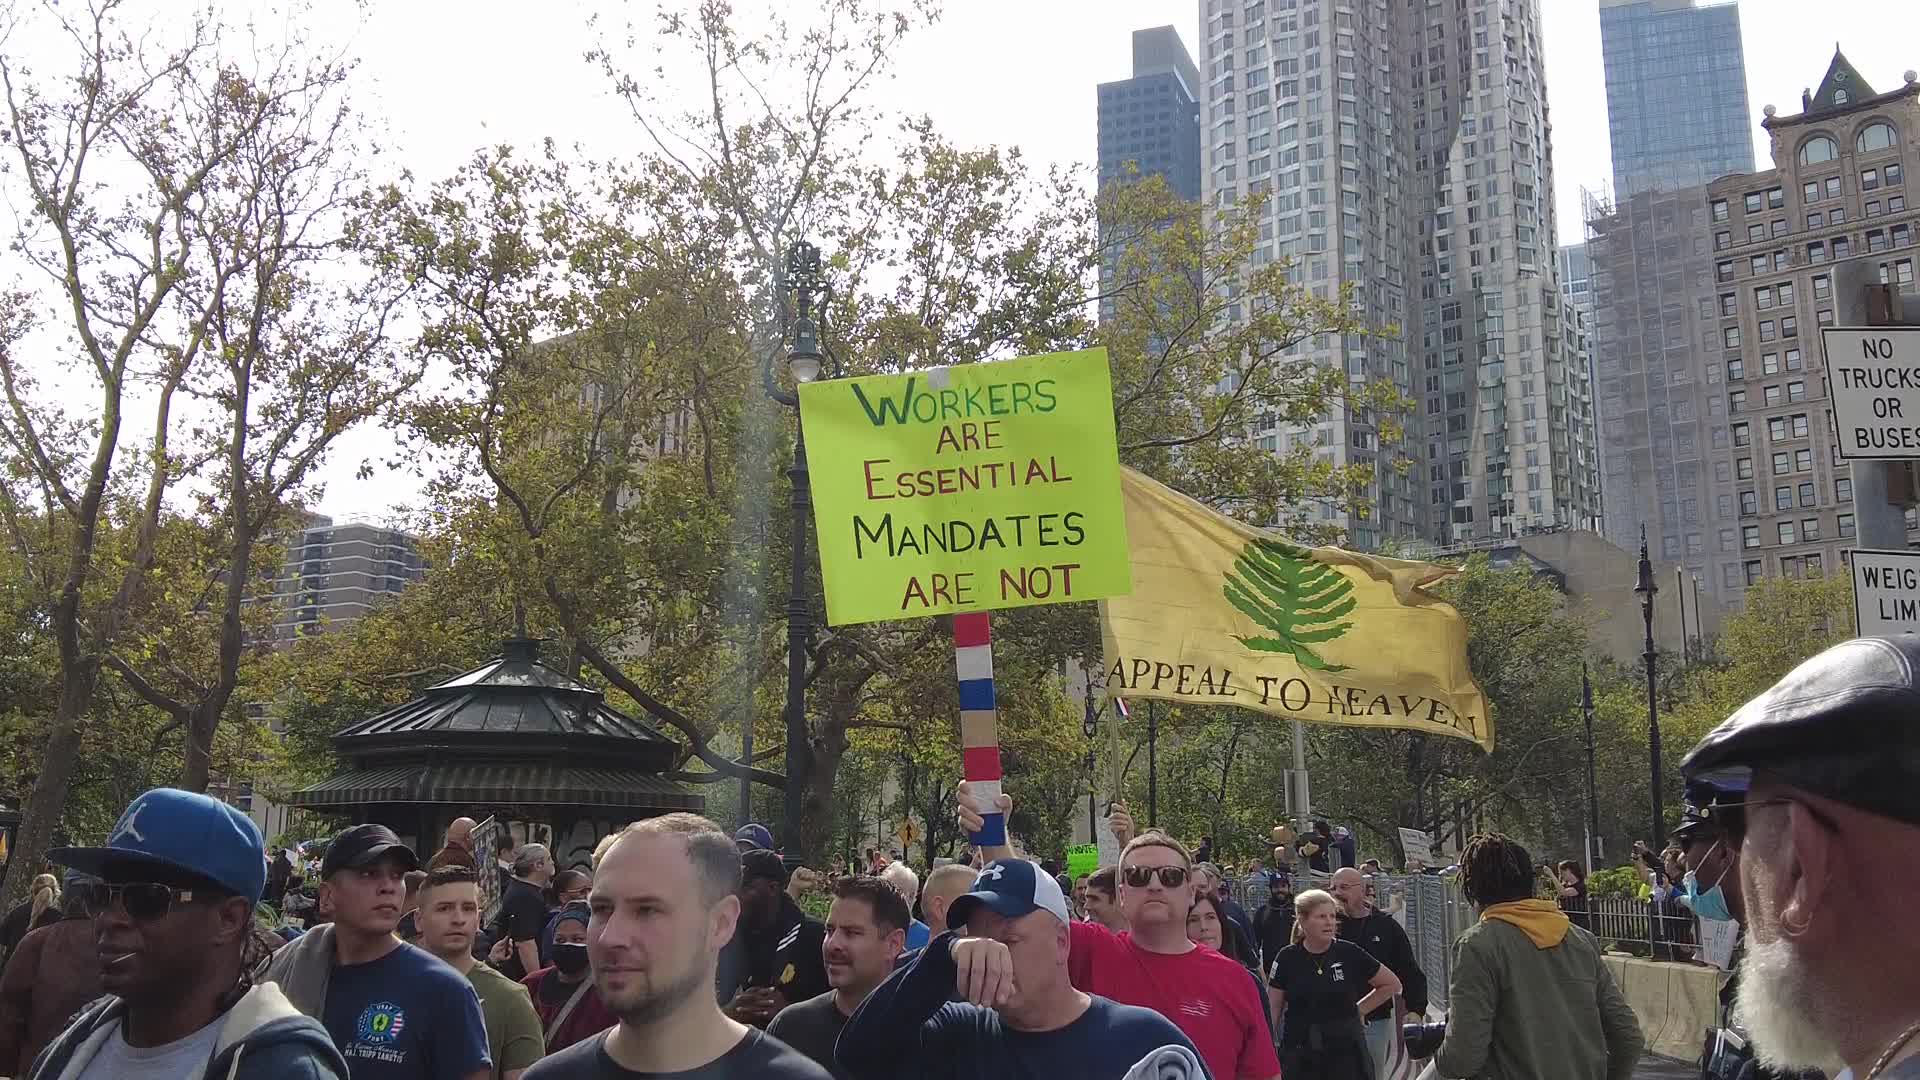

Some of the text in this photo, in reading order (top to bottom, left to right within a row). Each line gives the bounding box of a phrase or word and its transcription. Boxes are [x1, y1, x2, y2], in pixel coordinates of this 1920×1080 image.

[1862, 338, 1893, 359] NO
[851, 377, 1057, 426] WORKERS
[1872, 397, 1903, 418] OR
[936, 421, 1004, 454] ARE
[863, 456, 1073, 500] ESSENTIAL
[852, 512, 1085, 559] MANDATES
[901, 564, 1080, 610] ARE NOT
[1862, 566, 1920, 590] WEIG
[1879, 598, 1920, 621] LIM
[1105, 656, 1479, 739] APPEAL TO HEAVEN
